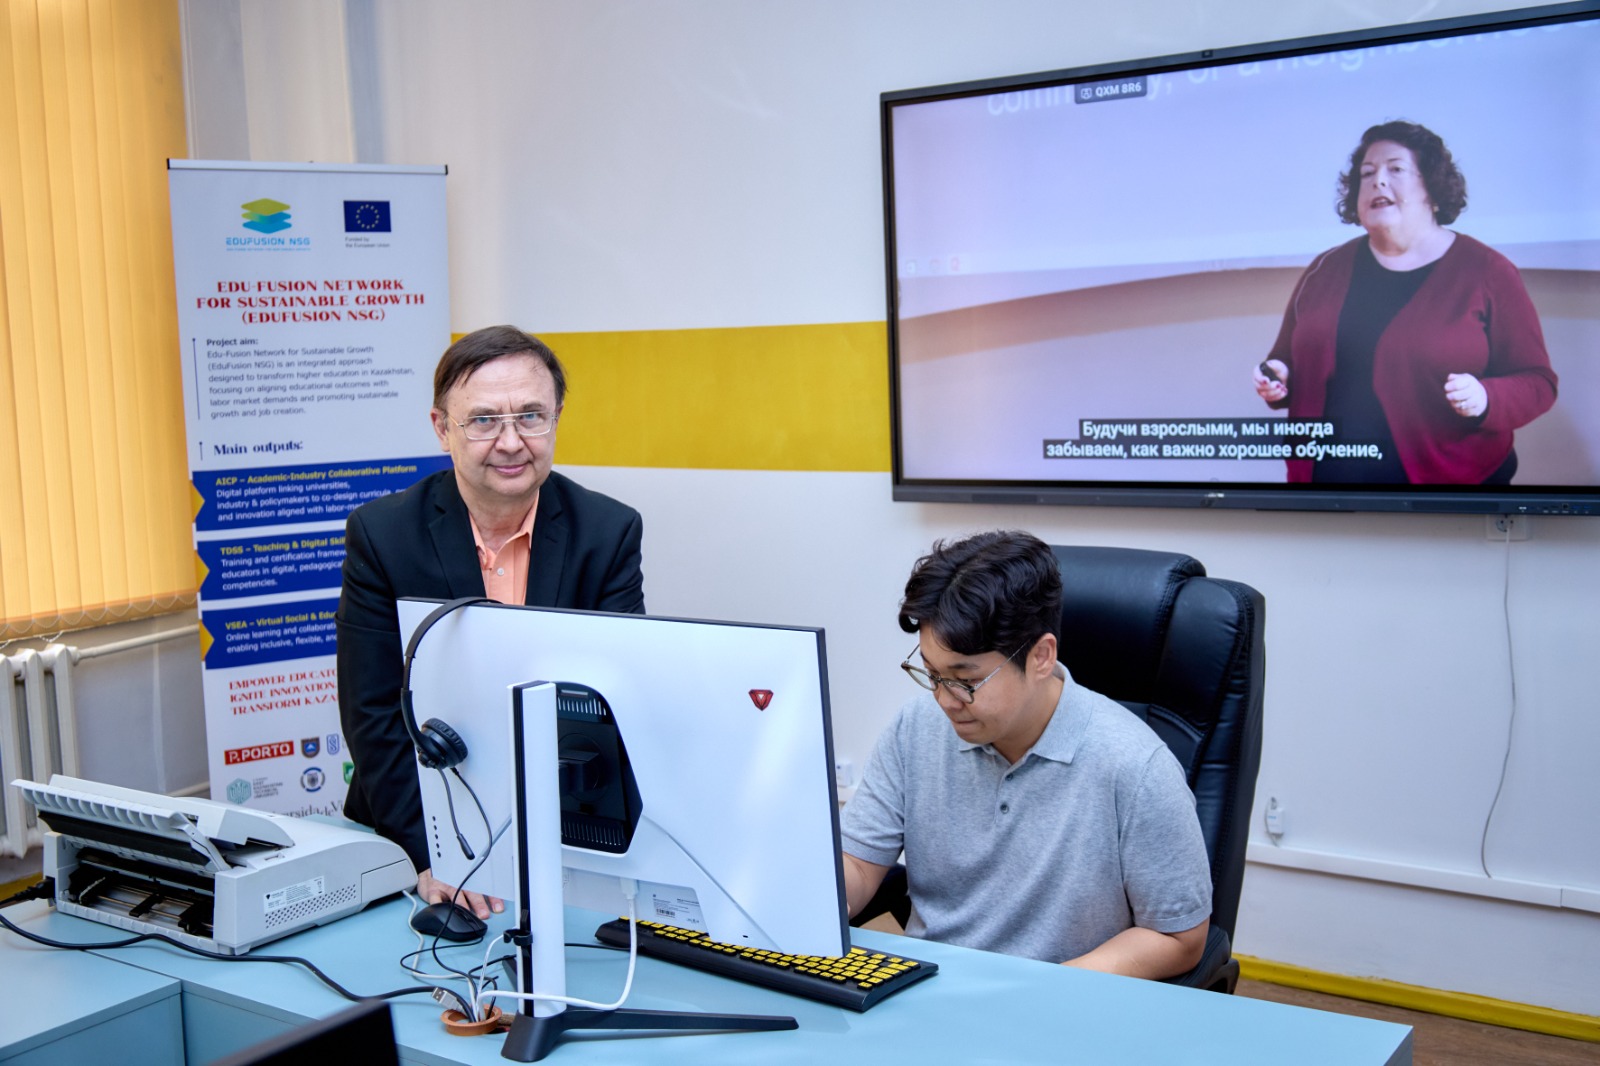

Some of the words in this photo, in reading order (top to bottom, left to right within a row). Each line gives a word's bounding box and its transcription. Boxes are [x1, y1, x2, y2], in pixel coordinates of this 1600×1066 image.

[1096, 84, 1119, 97] QXM
[1122, 82, 1142, 94] 8R6
[226, 237, 285, 246] EDUFUSION
[289, 237, 310, 246] NSG
[217, 280, 317, 292] EDU-FUSION
[324, 280, 404, 291] NETWORK
[196, 297, 231, 309] FOR
[238, 295, 349, 308] SUSTAINABLE
[355, 294, 424, 306] GROWTH
[242, 310, 341, 324] (EDUFUSION
[348, 308, 385, 321] NSG)
[206, 338, 237, 348] Project
[207, 350, 251, 358] Edu-Fusion
[208, 362, 252, 371] (EduFusion
[254, 361, 275, 369] NSG)
[297, 359, 336, 368] integrated
[338, 358, 372, 366] approach
[208, 374, 244, 383] designed
[256, 372, 294, 380] transform
[297, 371, 320, 380] higher
[371, 368, 414, 376] Kazakhstan,
[209, 386, 242, 395] focusing
[257, 384, 287, 393] aligning
[289, 382, 332, 390] educational
[263, 396, 297, 404] demands
[317, 393, 355, 402] promoting
[211, 410, 239, 420] growth
[258, 408, 271, 418] job
[273, 407, 306, 415] creation.
[1082, 421, 1137, 439] Будучи
[1141, 422, 1238, 438] взрослыми,
[1242, 423, 1269, 435] мы
[1274, 422, 1334, 438] иногда
[214, 444, 247, 456] Main
[253, 440, 303, 454] outputs:
[1047, 441, 1127, 458] забываем,
[1131, 445, 1158, 456] как
[1162, 444, 1215, 456] важно
[1219, 444, 1292, 460] хорошее
[1296, 441, 1383, 461] обучение,
[216, 477, 238, 486] AICP
[247, 471, 326, 484] Academic-Industry
[328, 467, 380, 479] Collaborative
[382, 465, 417, 474] Platform
[216, 488, 242, 498] Digital
[244, 486, 276, 497] platform
[278, 484, 304, 493] linking
[306, 481, 350, 491] universities,
[217, 501, 250, 510] industry
[252, 499, 258, 507] &
[260, 496, 309, 508] policymakers
[322, 492, 358, 502] co-design
[218, 513, 233, 522] and
[235, 509, 275, 520] innovation
[277, 507, 305, 518] aligned
[307, 506, 324, 514] with
[220, 546, 243, 556] TDSS
[253, 542, 290, 552] Teaching
[301, 538, 328, 548] Digital
[221, 558, 252, 567] Training
[255, 556, 269, 564] and
[271, 551, 315, 562] certification
[317, 549, 347, 558] framew
[222, 569, 260, 579] educators
[272, 565, 297, 575] digital,
[222, 579, 277, 591] competencies.
[225, 621, 247, 630] VSEA
[256, 616, 283, 625] Virtual
[285, 614, 308, 623] Social
[226, 633, 250, 642] Online
[252, 629, 281, 639] learning
[227, 643, 258, 653] enabling
[260, 640, 293, 649] inclusive,
[296, 637, 323, 645] flexible,
[229, 675, 286, 690] EMPOWER
[230, 690, 266, 703] IGNITE
[231, 698, 300, 715] TRANSFORM
[305, 693, 339, 705] KAZA
